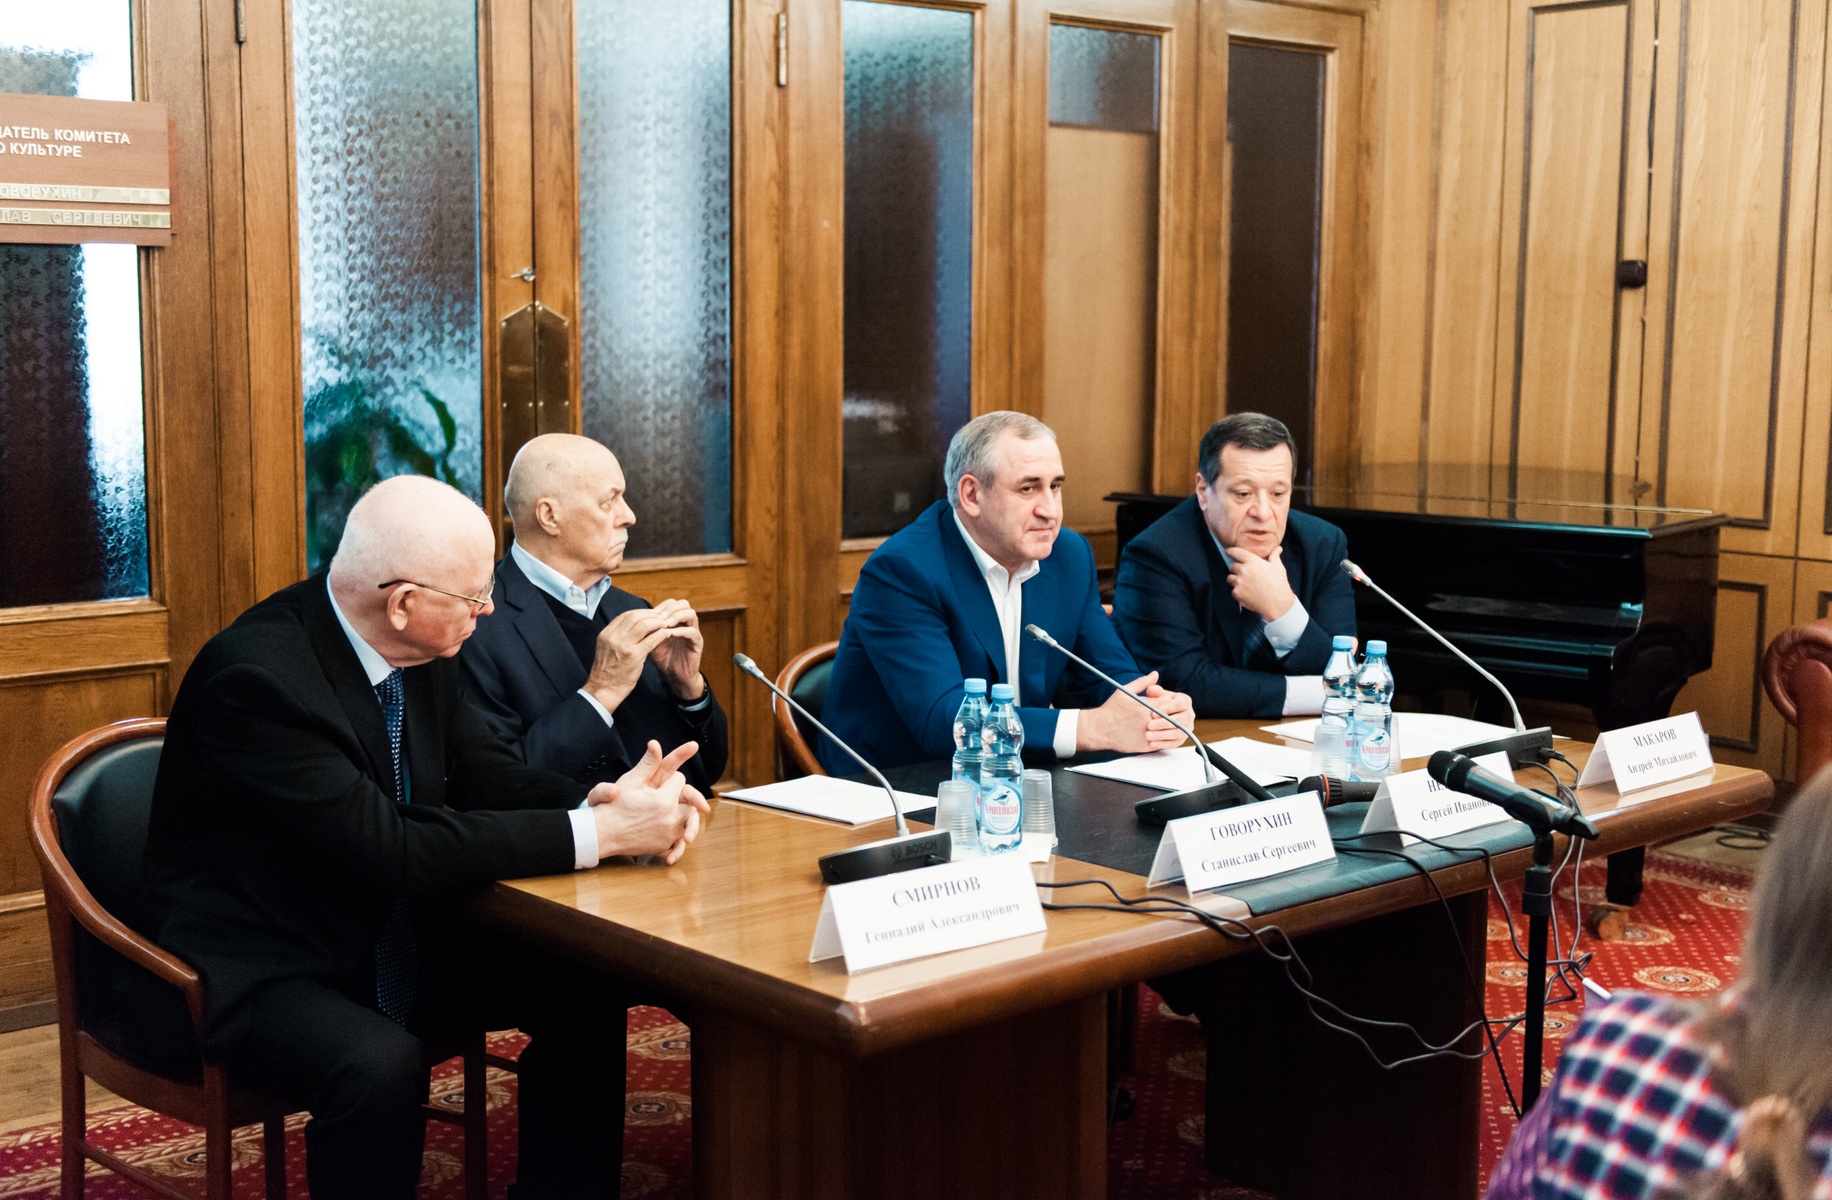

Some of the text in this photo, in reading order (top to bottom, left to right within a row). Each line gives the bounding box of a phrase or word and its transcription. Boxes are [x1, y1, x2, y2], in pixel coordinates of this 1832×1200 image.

[0, 126, 131, 145] АТЕЛЬ КОМИТЕТА
[10, 142, 83, 158] КУЛЬТУРЕ
[51, 211, 141, 225] СЕРГЕЕВИЧ
[1633, 728, 1677, 748] МАКАРОВ
[1627, 750, 1698, 775] Андрей Михайлович
[1421, 800, 1493, 822] Сергей Иванови
[1210, 811, 1293, 841] ГОВОРУХИН
[905, 839, 938, 855] BOSCH
[1201, 851, 1261, 873] Станислав
[1262, 840, 1317, 860] Сергеевич
[892, 876, 981, 907] СМИРНОВ
[864, 903, 1020, 944] Геннадий Александрович
